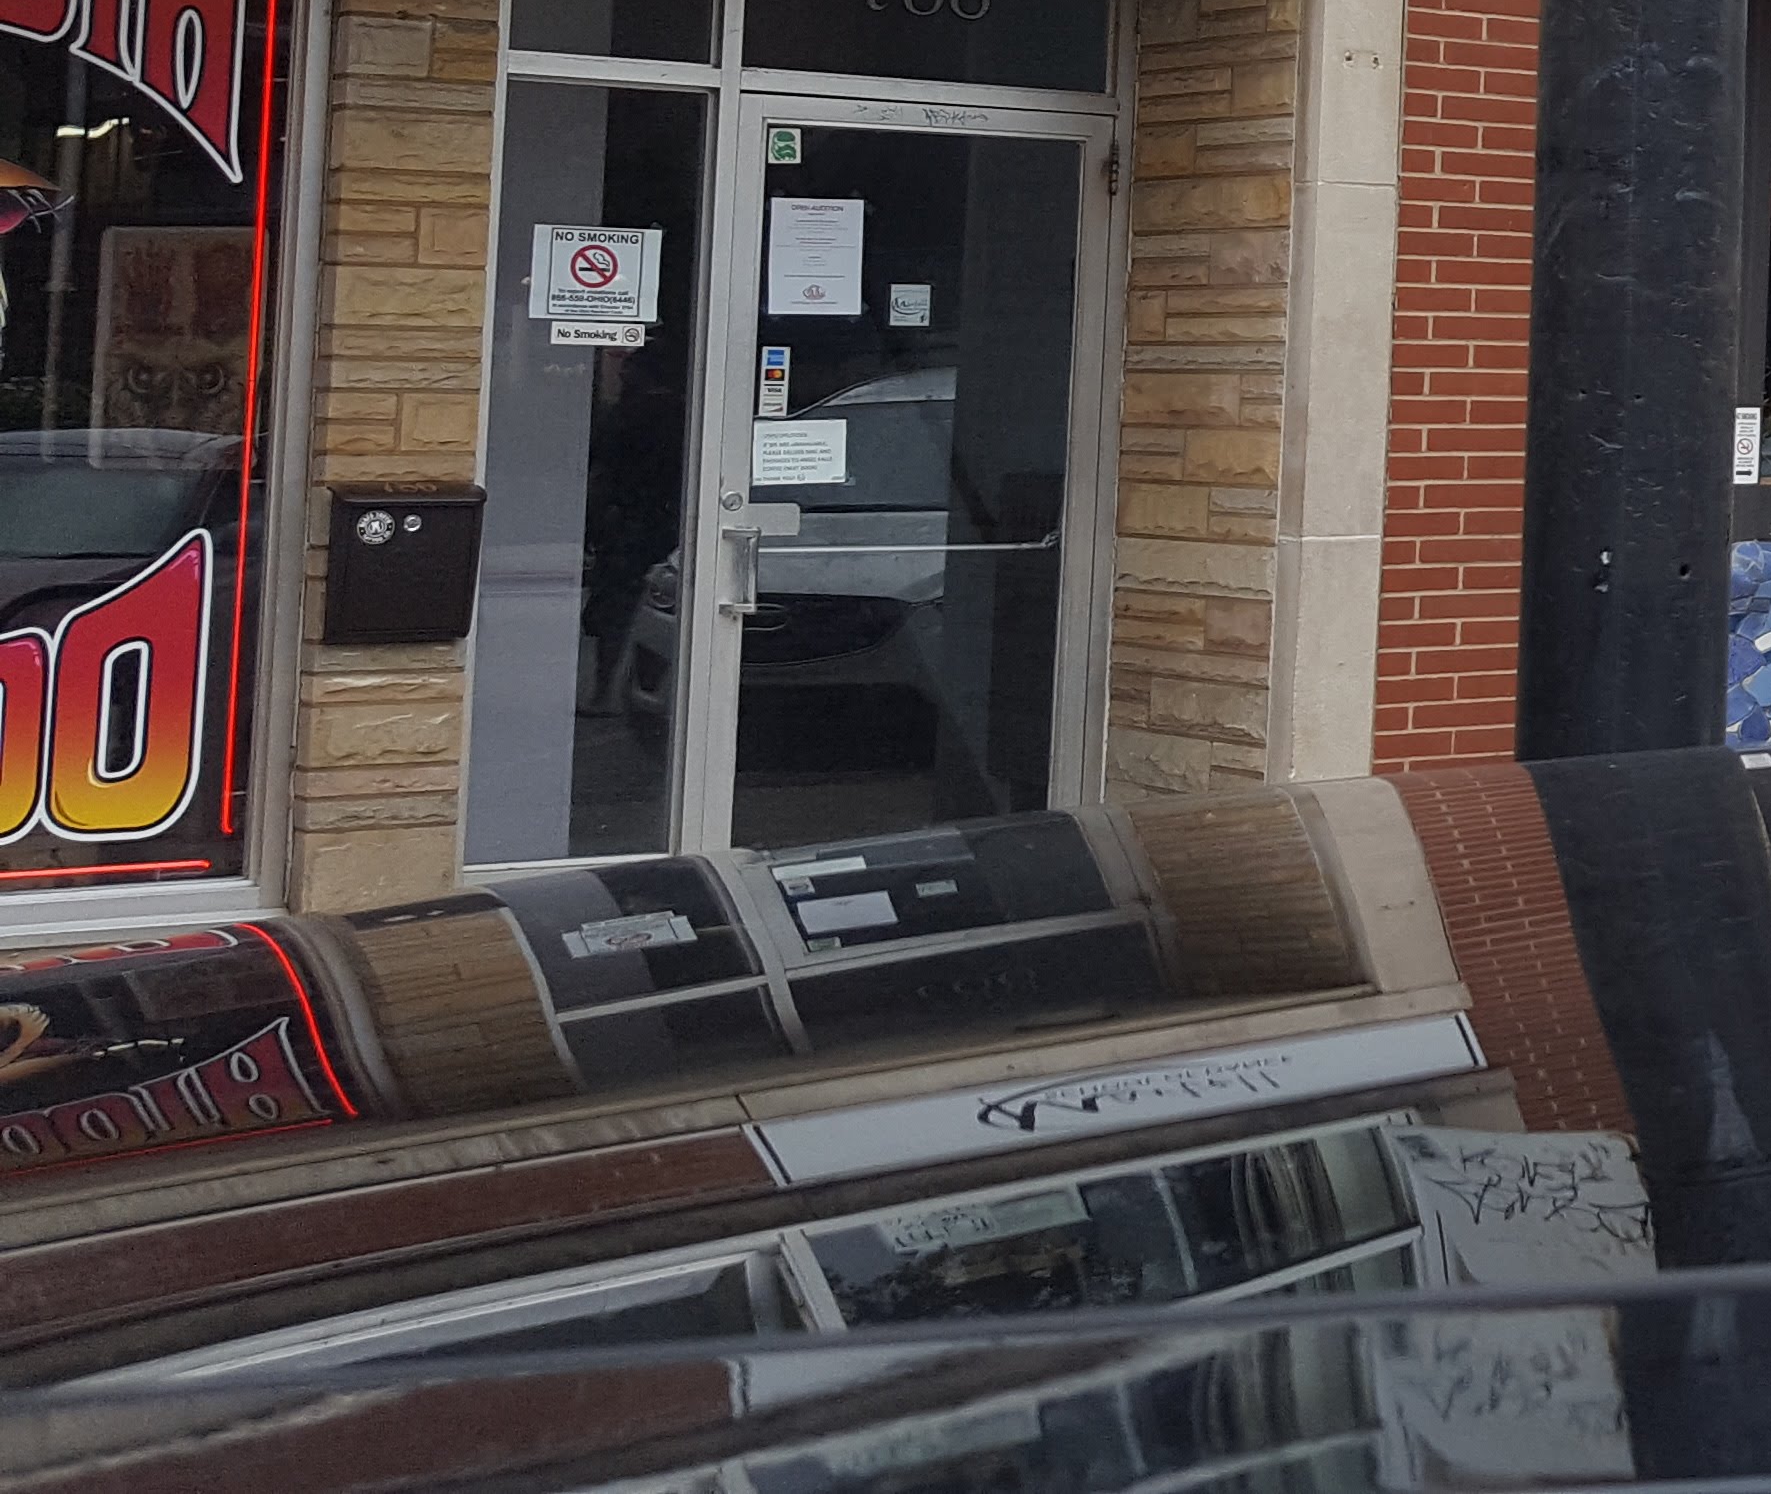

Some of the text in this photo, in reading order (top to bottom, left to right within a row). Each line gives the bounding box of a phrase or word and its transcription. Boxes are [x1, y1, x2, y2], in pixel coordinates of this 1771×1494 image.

[555, 231, 640, 244] NO SMOKING
[556, 329, 618, 342] No Smoking
